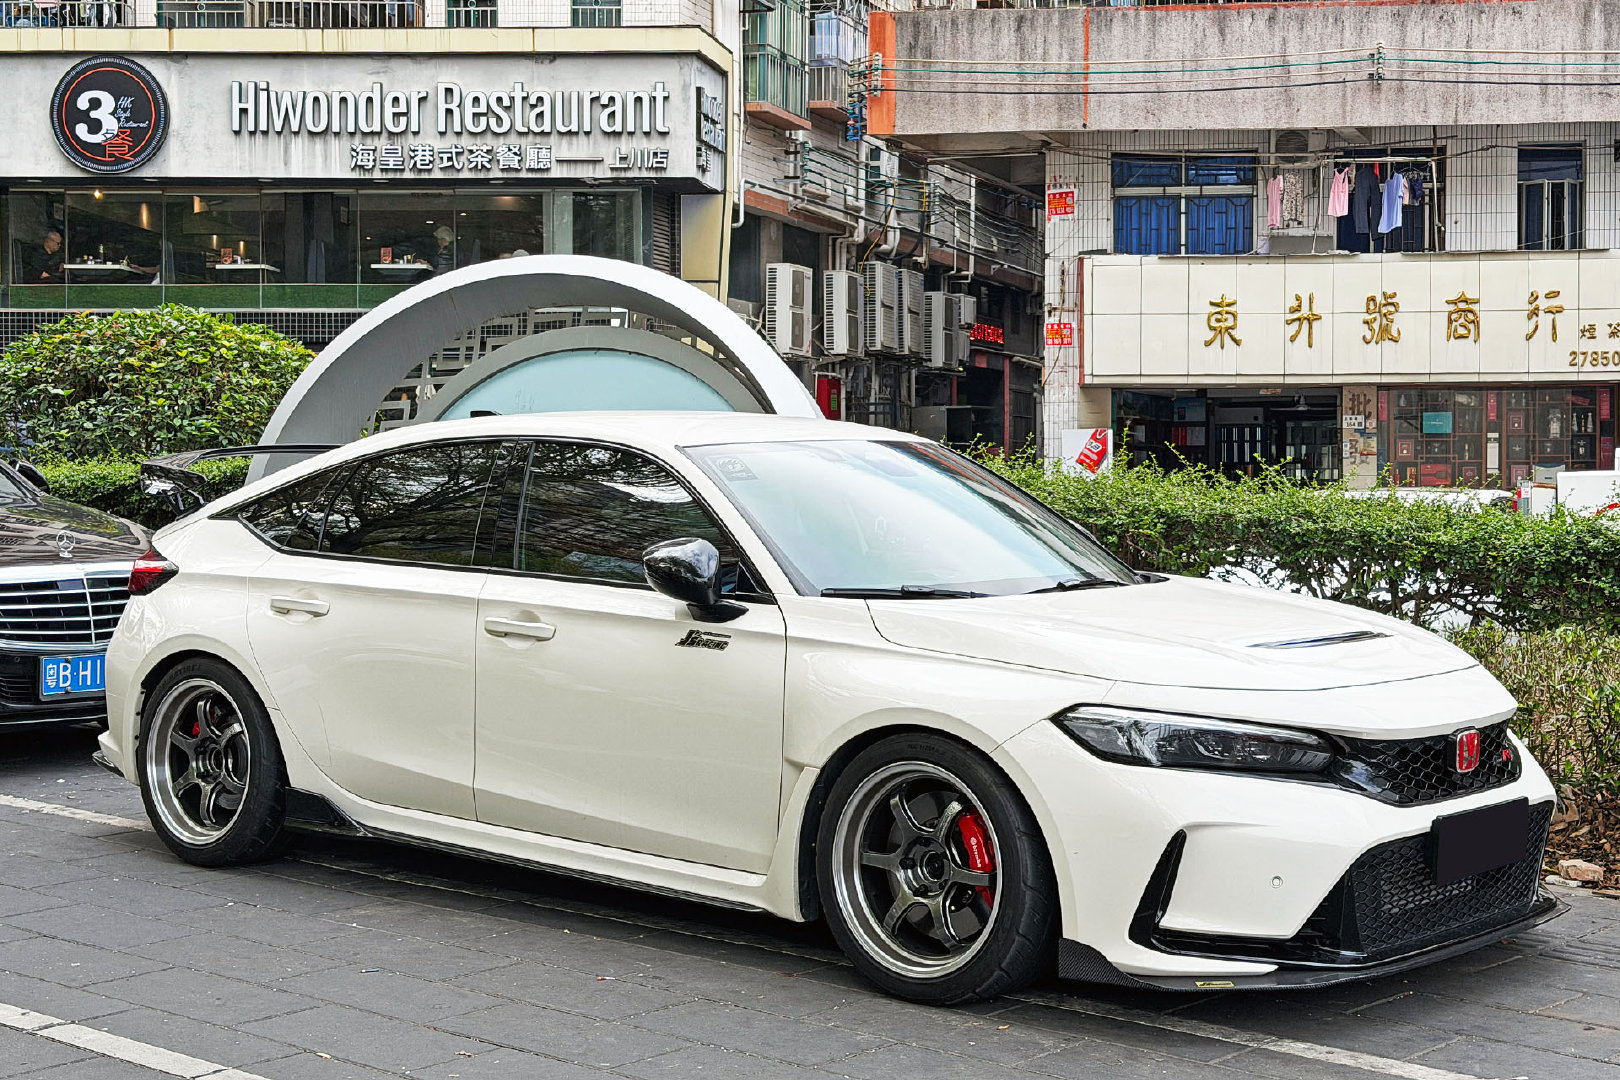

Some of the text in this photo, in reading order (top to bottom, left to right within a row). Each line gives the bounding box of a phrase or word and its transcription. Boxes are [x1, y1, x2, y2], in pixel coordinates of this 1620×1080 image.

[75, 90, 119, 143] 3
[117, 96, 135, 108] HK
[231, 81, 428, 133] Hiwonder
[437, 82, 670, 134] Restaurant
[608, 147, 669, 168] 上川店
